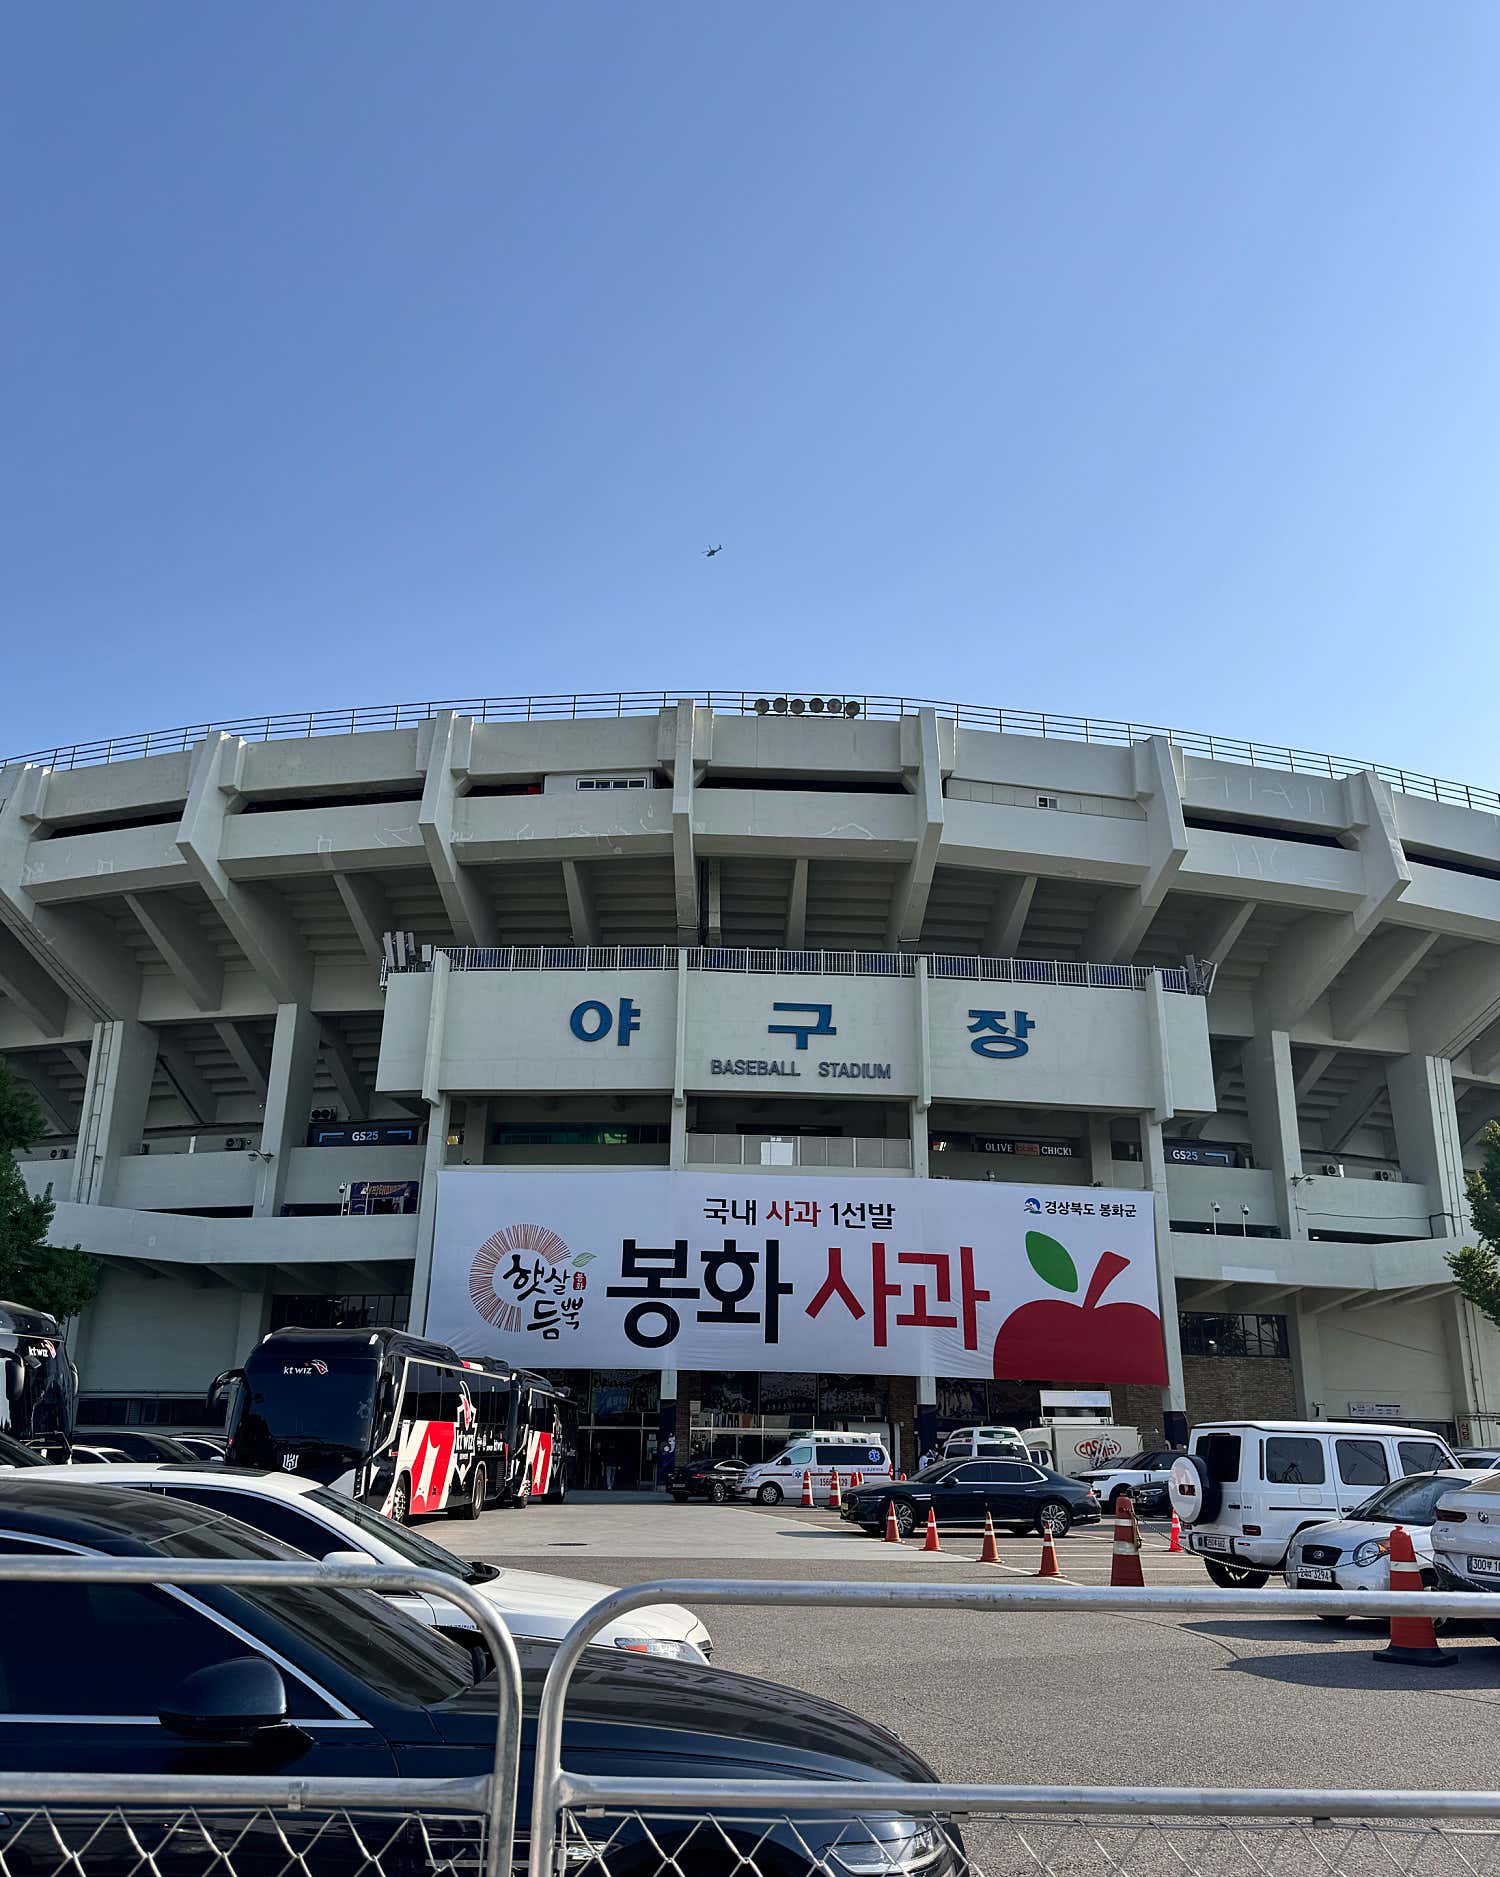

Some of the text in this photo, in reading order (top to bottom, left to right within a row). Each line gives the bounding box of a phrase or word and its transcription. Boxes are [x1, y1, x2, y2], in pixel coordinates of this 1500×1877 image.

[710, 1058, 892, 1080] BASEBALL STADIUM
[351, 1131, 379, 1141] GS25
[985, 1142, 1013, 1153] OLIVE
[1172, 1150, 1198, 1161] GS25
[703, 1198, 896, 1230] 국내 사과 1선발
[1044, 1200, 1137, 1218] 경상북도 봉화군
[502, 1254, 571, 1302] 햇살
[605, 1238, 991, 1351] 봉화 사과
[526, 1297, 584, 1340] 듬뿍
